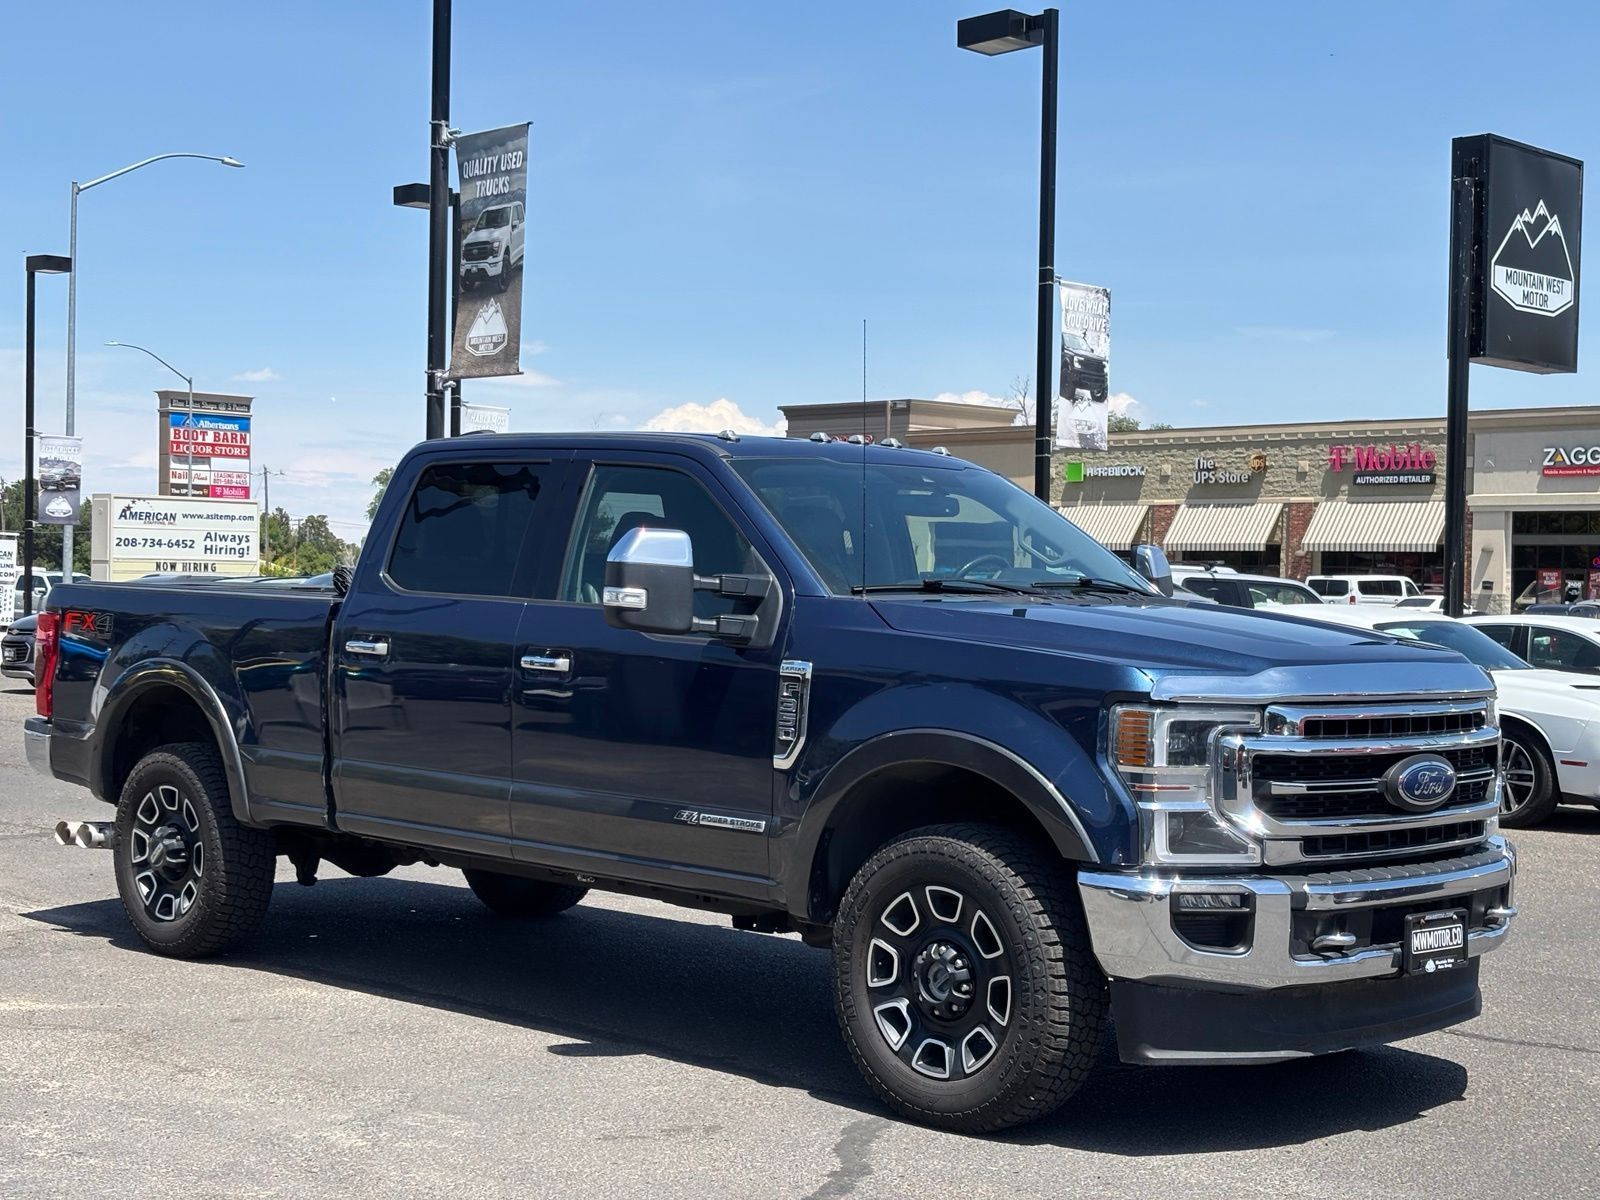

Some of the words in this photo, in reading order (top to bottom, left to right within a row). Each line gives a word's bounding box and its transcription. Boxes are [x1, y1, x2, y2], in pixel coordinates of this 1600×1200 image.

[463, 155, 499, 179] QUALITY
[500, 150, 523, 171] USED
[475, 175, 510, 198] TRUCKS
[1505, 268, 1545, 291] MOUNTAIN
[1545, 277, 1565, 295] WEST
[1522, 289, 1549, 308] MOTOR
[1066, 296, 1086, 312] LOVE
[1085, 299, 1107, 316] WHAT
[1066, 312, 1081, 328] YOU
[1083, 315, 1107, 332] DRIVE
[199, 420, 239, 430] Albertsons
[173, 428, 208, 442] BOOT
[213, 431, 247, 445] BARN
[172, 443, 213, 455] LIQUOR
[214, 446, 248, 456] STORE
[1354, 442, 1436, 471] Mobile
[1542, 446, 1600, 466] ZAGG
[1194, 456, 1215, 470] The
[1251, 459, 1265, 470] ups
[1107, 465, 1145, 477] BLOCK
[1193, 471, 1216, 484] UPS
[1219, 471, 1249, 483] Store
[1356, 476, 1399, 484] AUTHORIZED
[1400, 475, 1431, 483] RETAILER
[223, 487, 246, 496] Mobile
[118, 509, 177, 521] AMERICAN
[182, 512, 255, 522] www.asitemp.com
[115, 537, 196, 549] 208-734-6452
[204, 531, 251, 545] Always
[204, 545, 251, 558] Hiring!
[155, 561, 177, 572] NOW
[182, 562, 217, 573] HIRING
[63, 611, 114, 633] FX4
[1414, 771, 1446, 796] Ford
[701, 815, 728, 824] POWER
[729, 819, 762, 829] STROKE
[1413, 927, 1462, 951] MWMOTOR.CO
